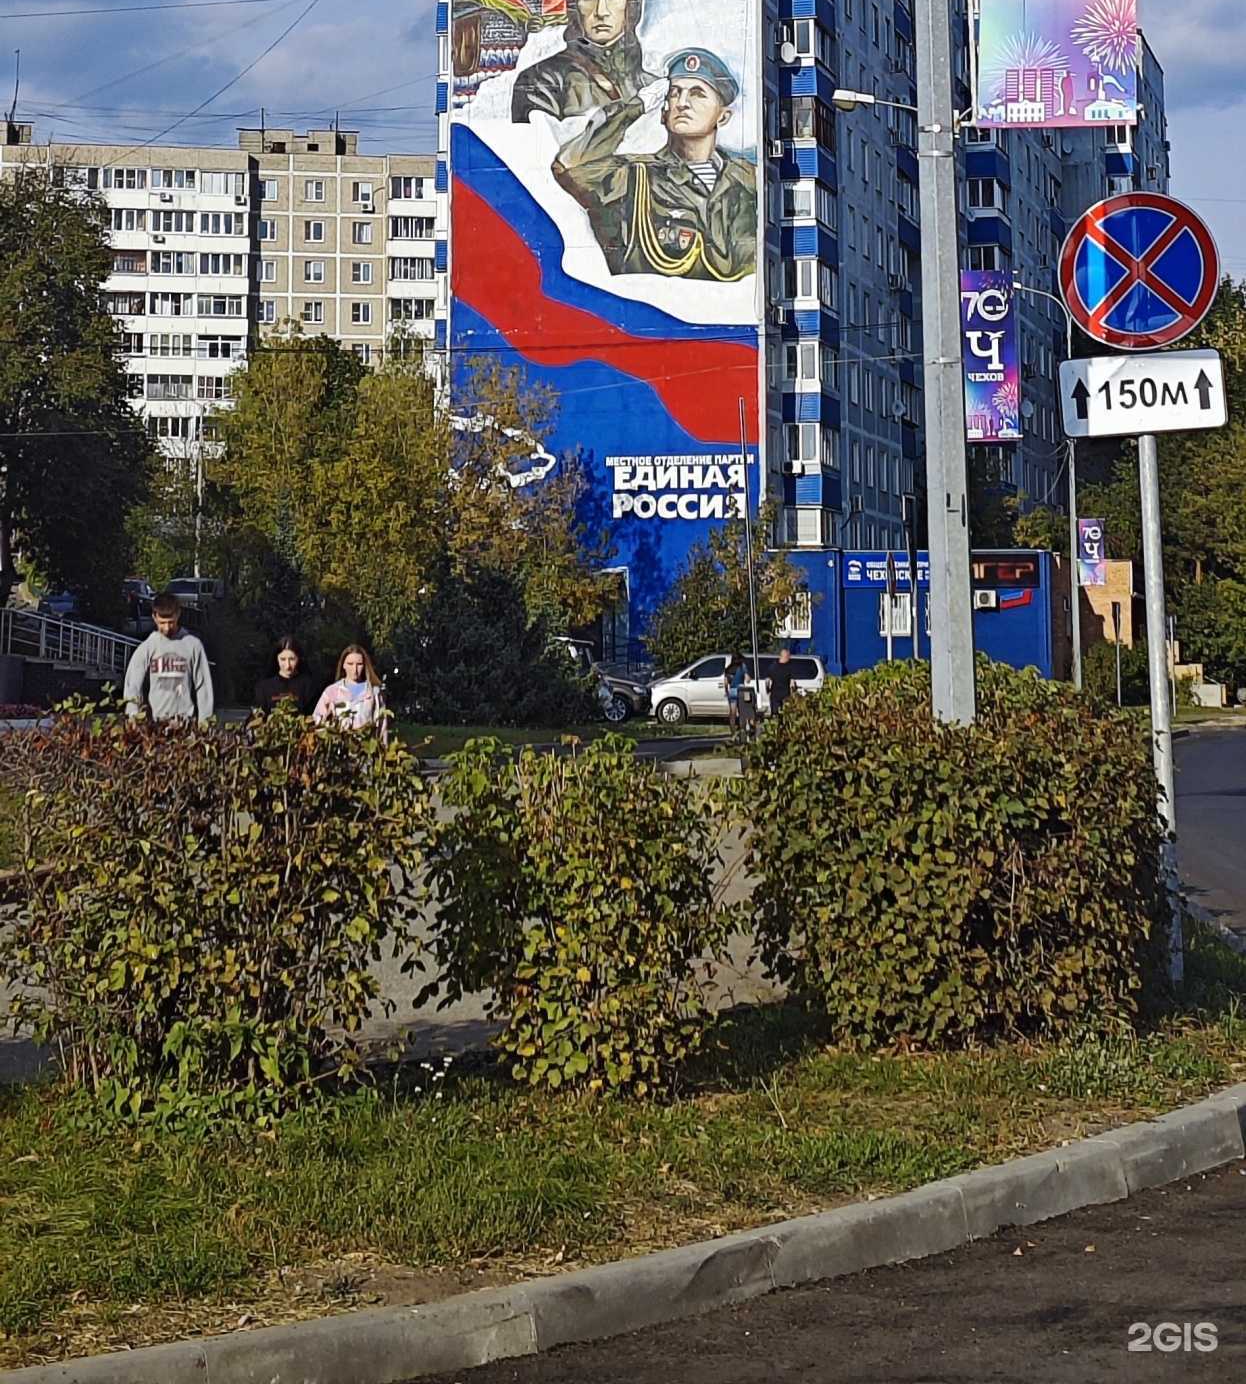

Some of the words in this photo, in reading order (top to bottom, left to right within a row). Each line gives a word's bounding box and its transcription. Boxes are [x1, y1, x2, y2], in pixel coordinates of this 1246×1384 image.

[961, 289, 1009, 322] 70
[965, 331, 1005, 370] Ч
[968, 372, 1005, 382] ЧЕХОВ
[605, 456, 652, 467] МЕСТНОЕ
[614, 465, 745, 491] ЕДИНАЯ
[612, 493, 747, 519] РОССИЯ
